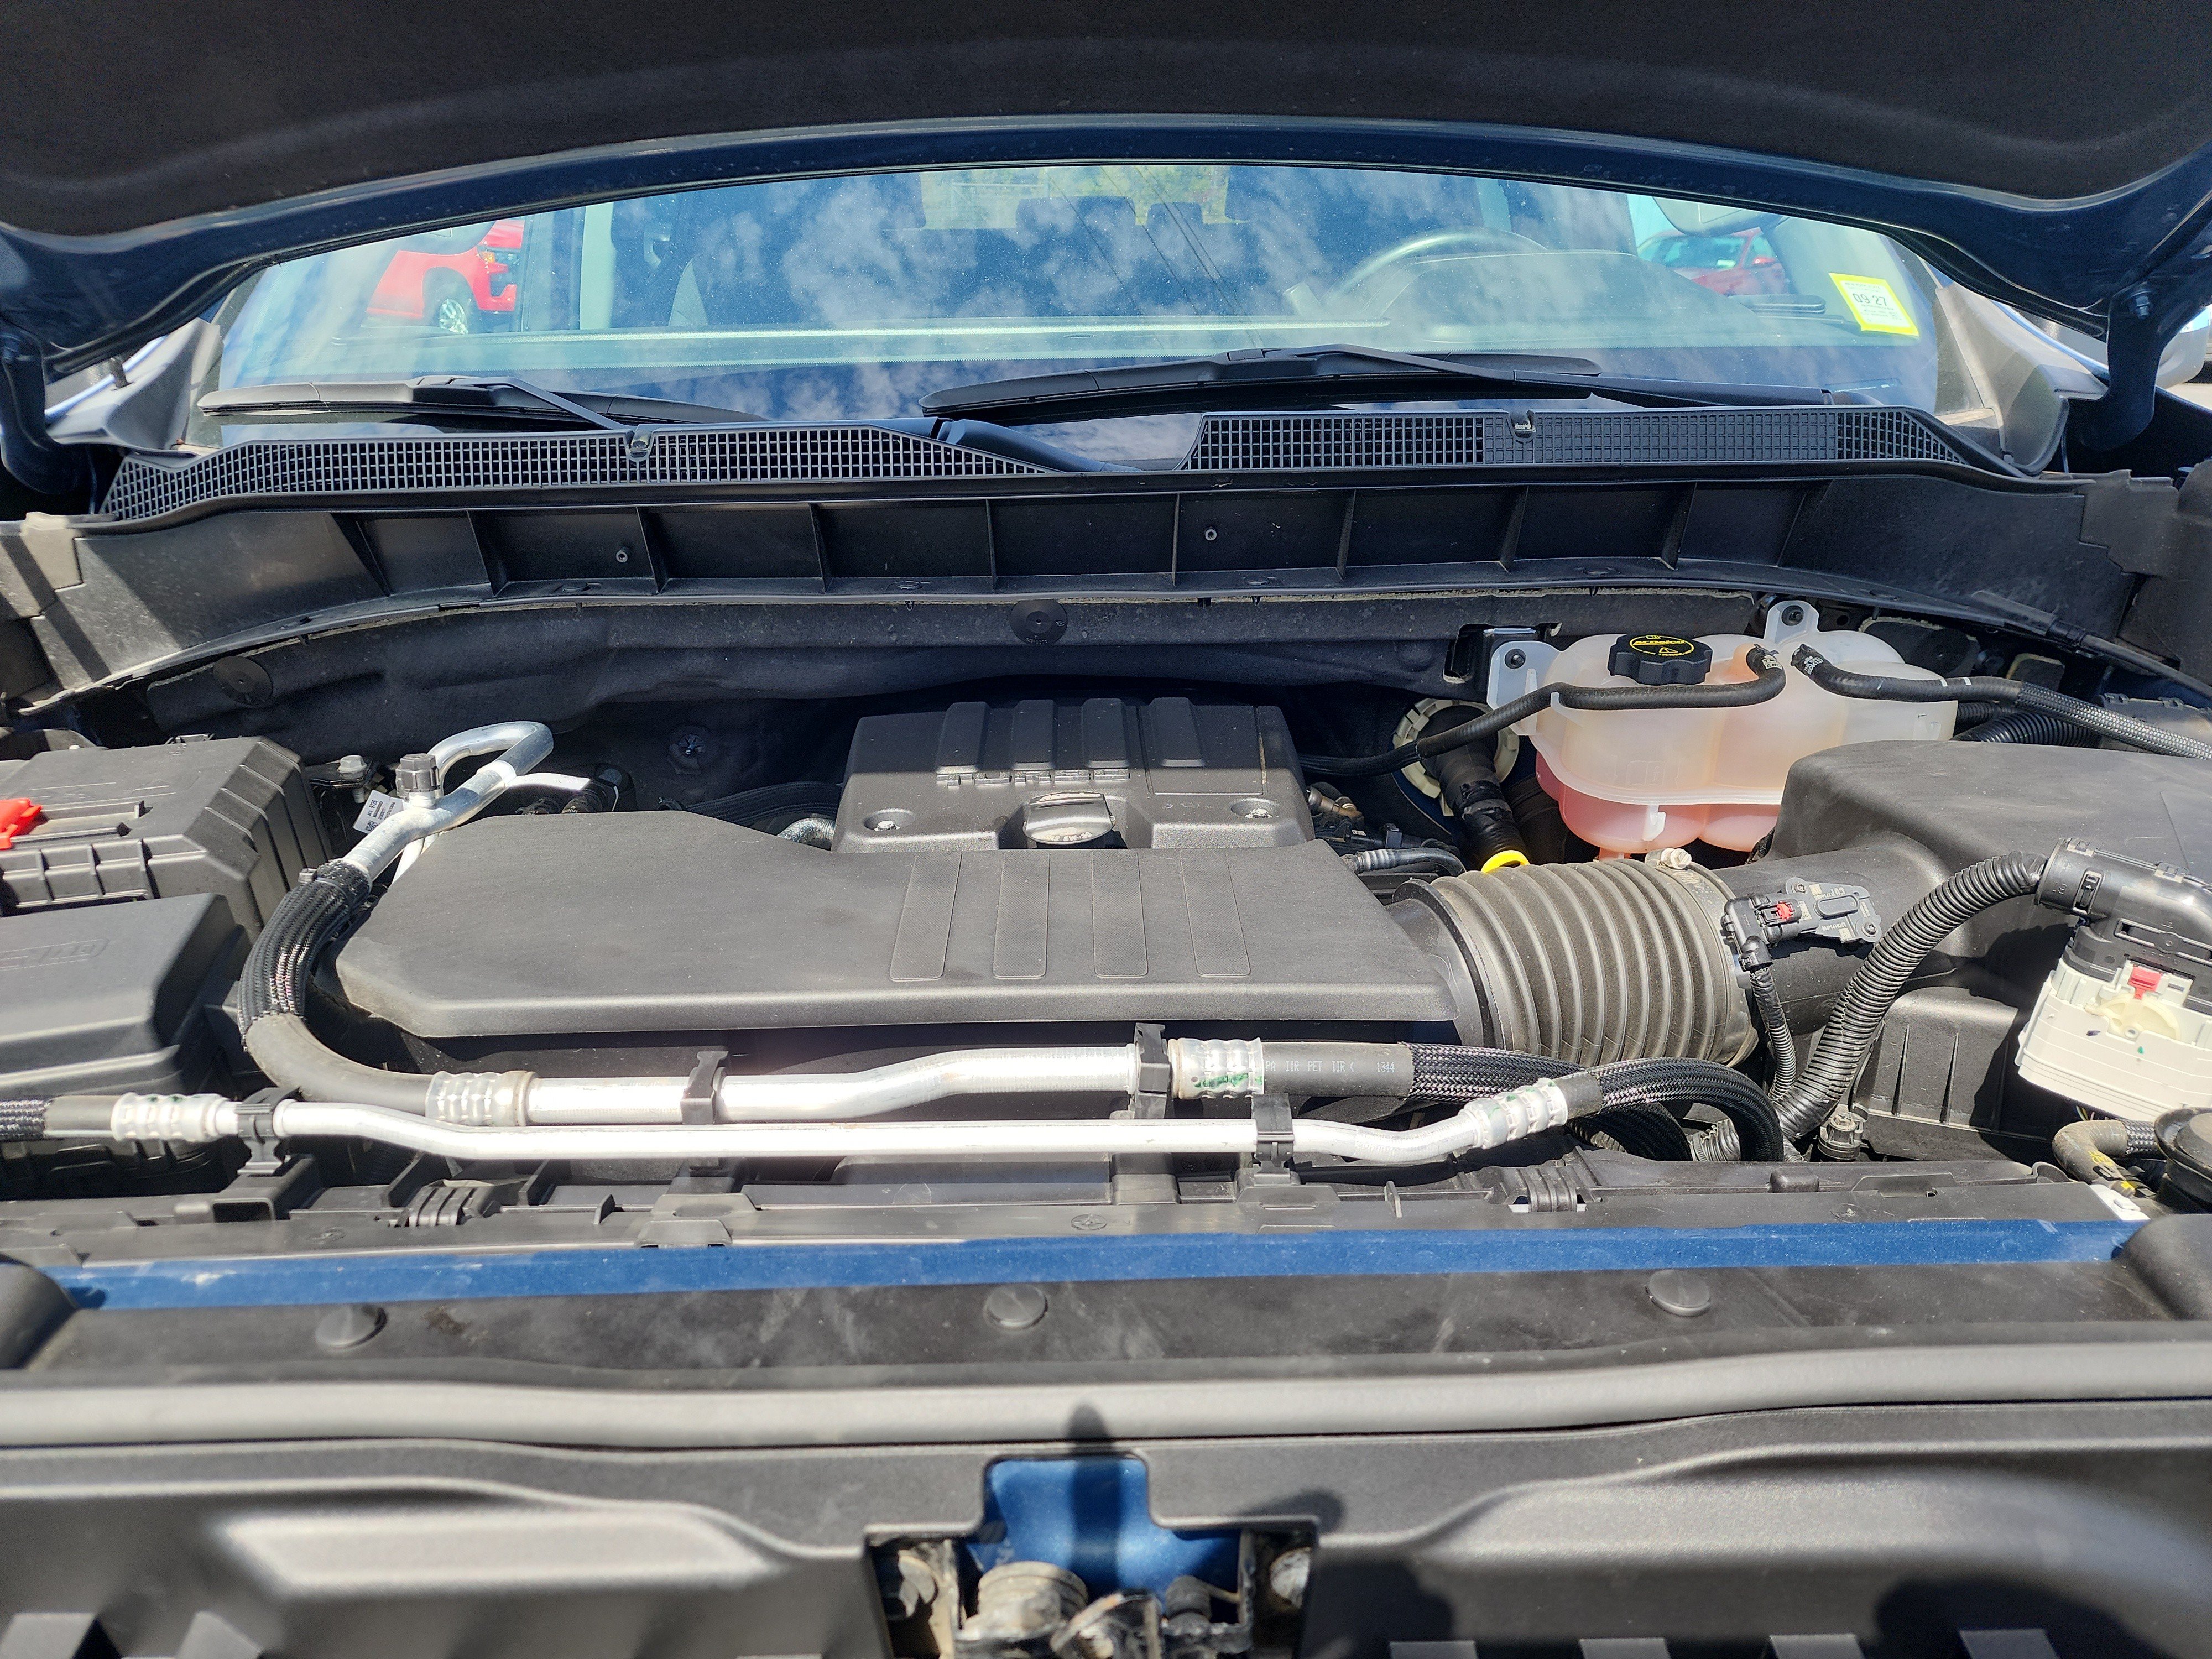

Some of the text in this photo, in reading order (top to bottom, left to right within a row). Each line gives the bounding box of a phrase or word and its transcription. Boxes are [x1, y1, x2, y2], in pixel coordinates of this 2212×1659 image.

[1852, 293, 1887, 306] 09 27
[1265, 1060, 1276, 1072] PA
[1286, 1061, 1300, 1072] IIR
[1307, 1061, 1322, 1072] PET
[1376, 1062, 1395, 1073] 1344
